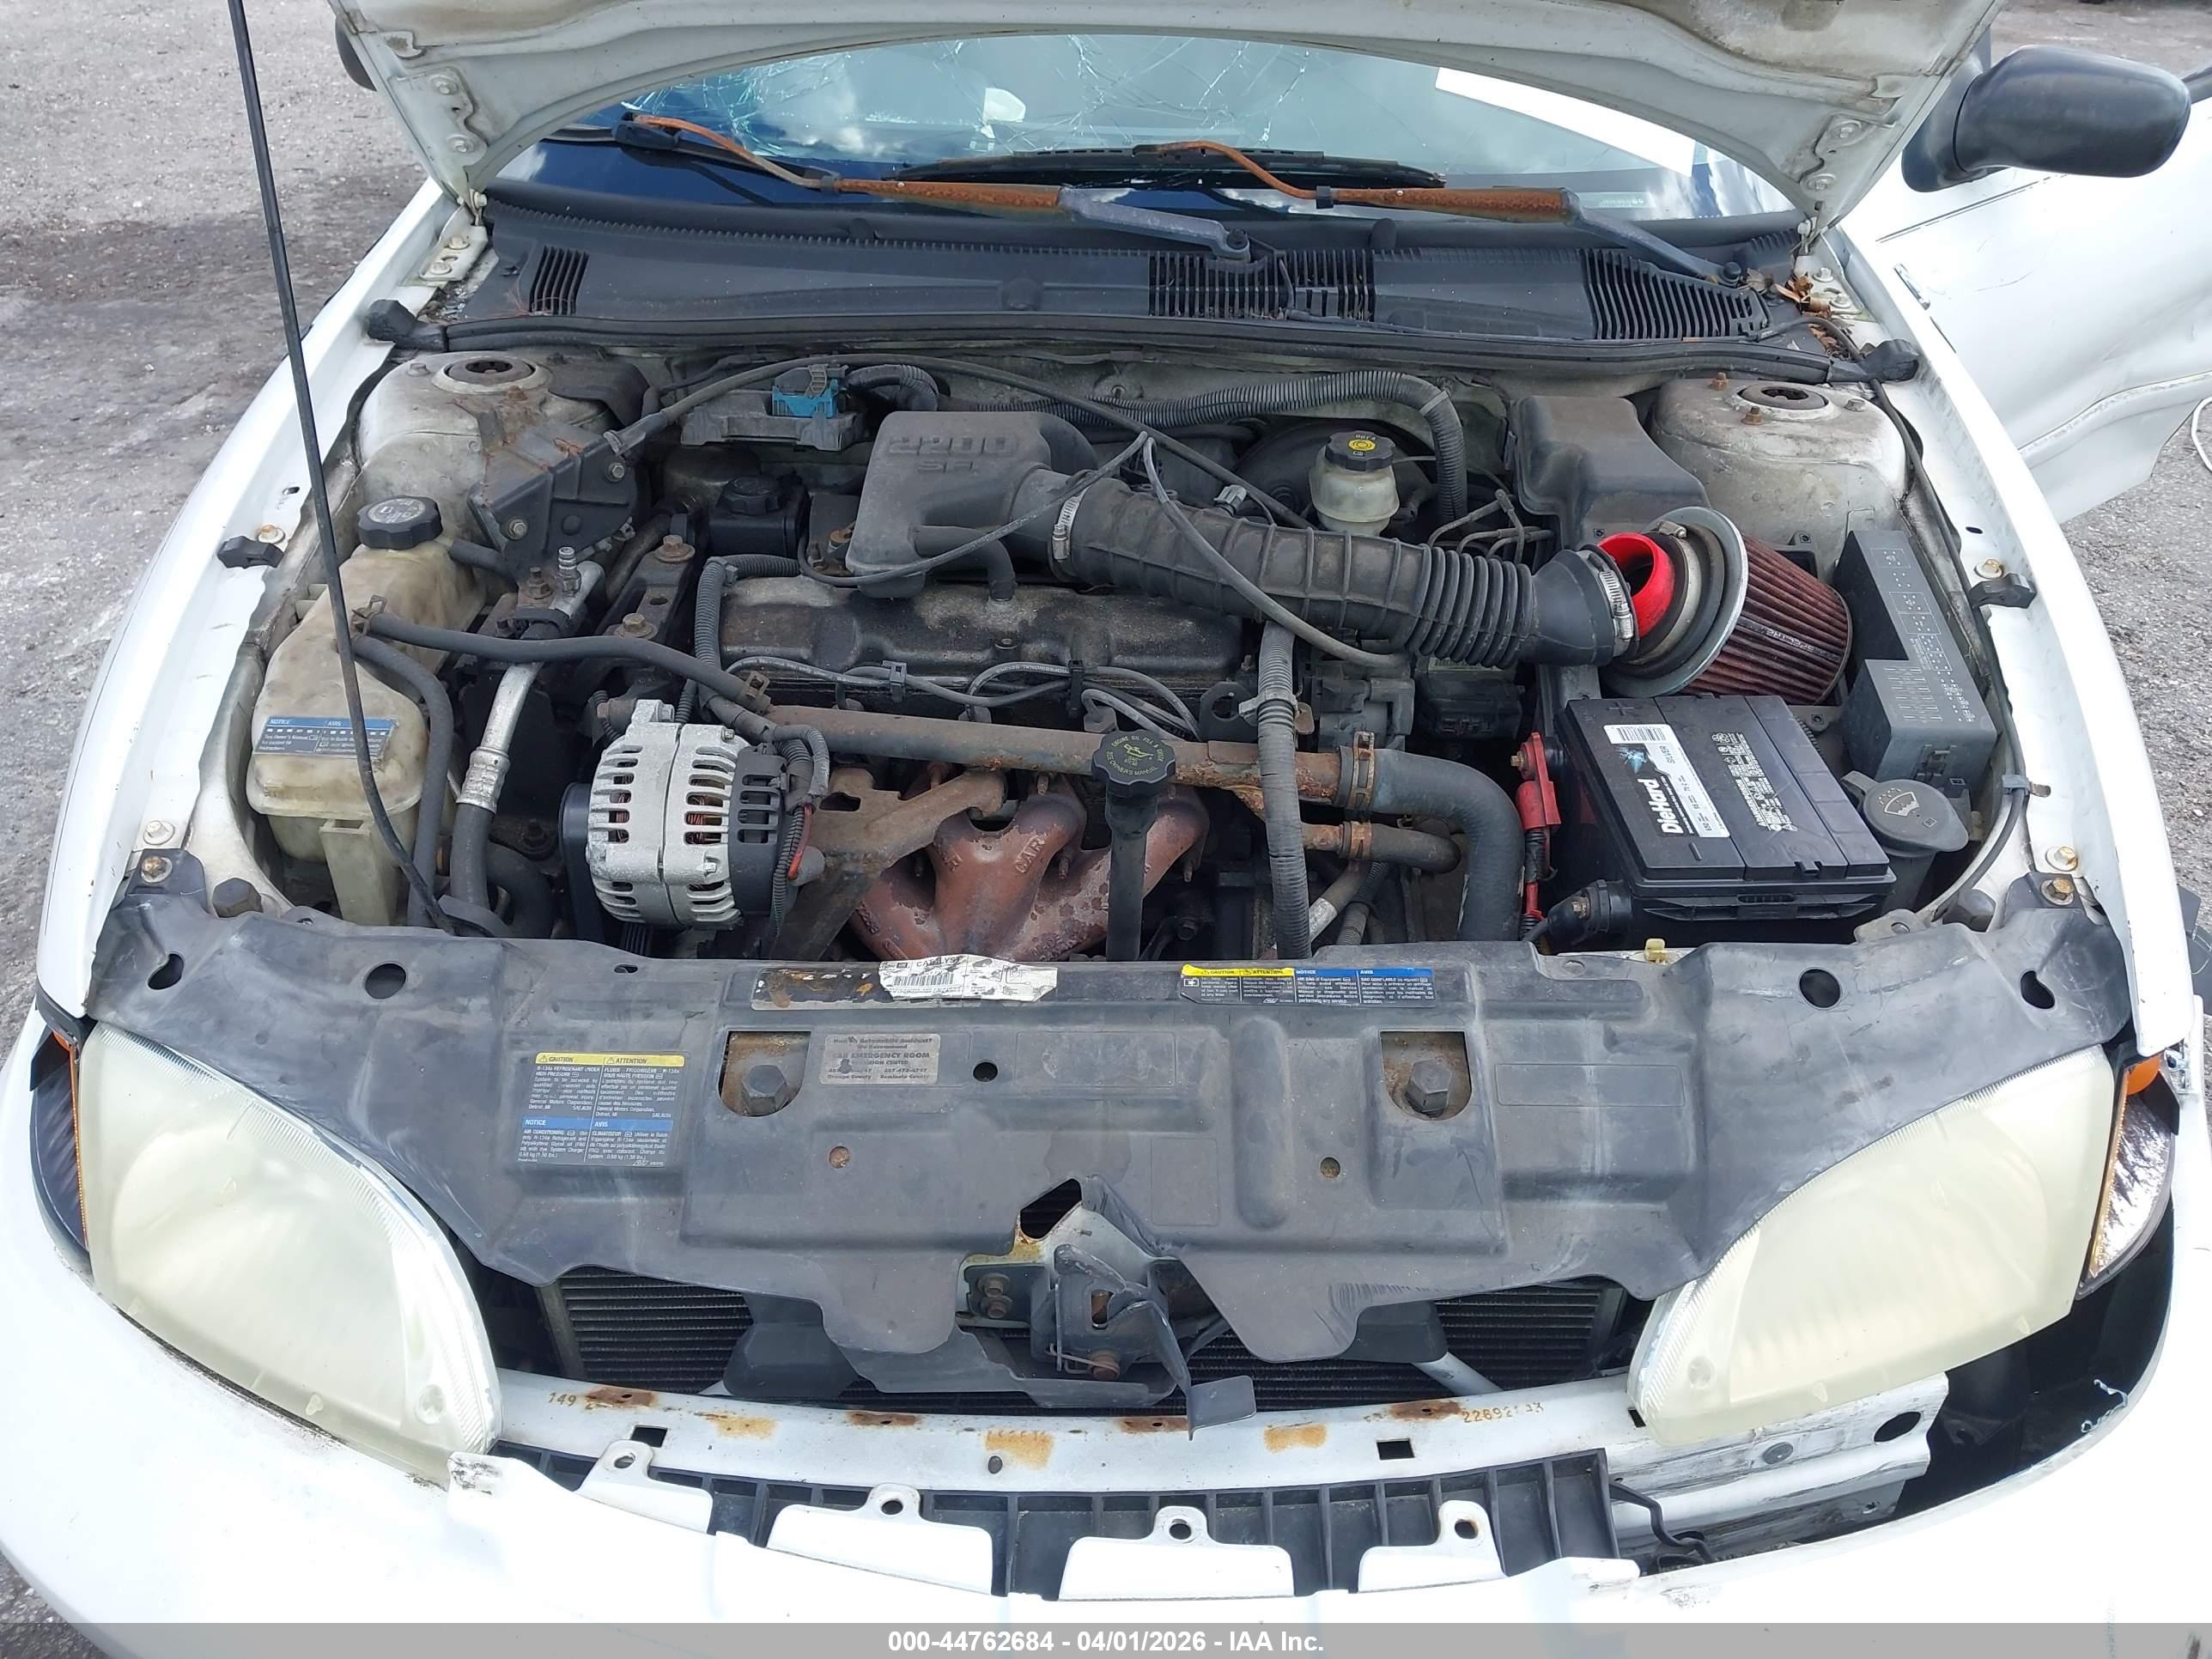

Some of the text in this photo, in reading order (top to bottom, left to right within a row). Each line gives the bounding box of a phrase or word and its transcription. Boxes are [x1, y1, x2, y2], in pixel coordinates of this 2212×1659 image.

[888, 437, 1018, 456] 2200
[1659, 745, 1676, 764] SILVER
[1735, 780, 1752, 799] POISON
[1637, 778, 1684, 833] DieHard
[916, 957, 963, 967] CATALYST
[549, 1393, 577, 1407] 149
